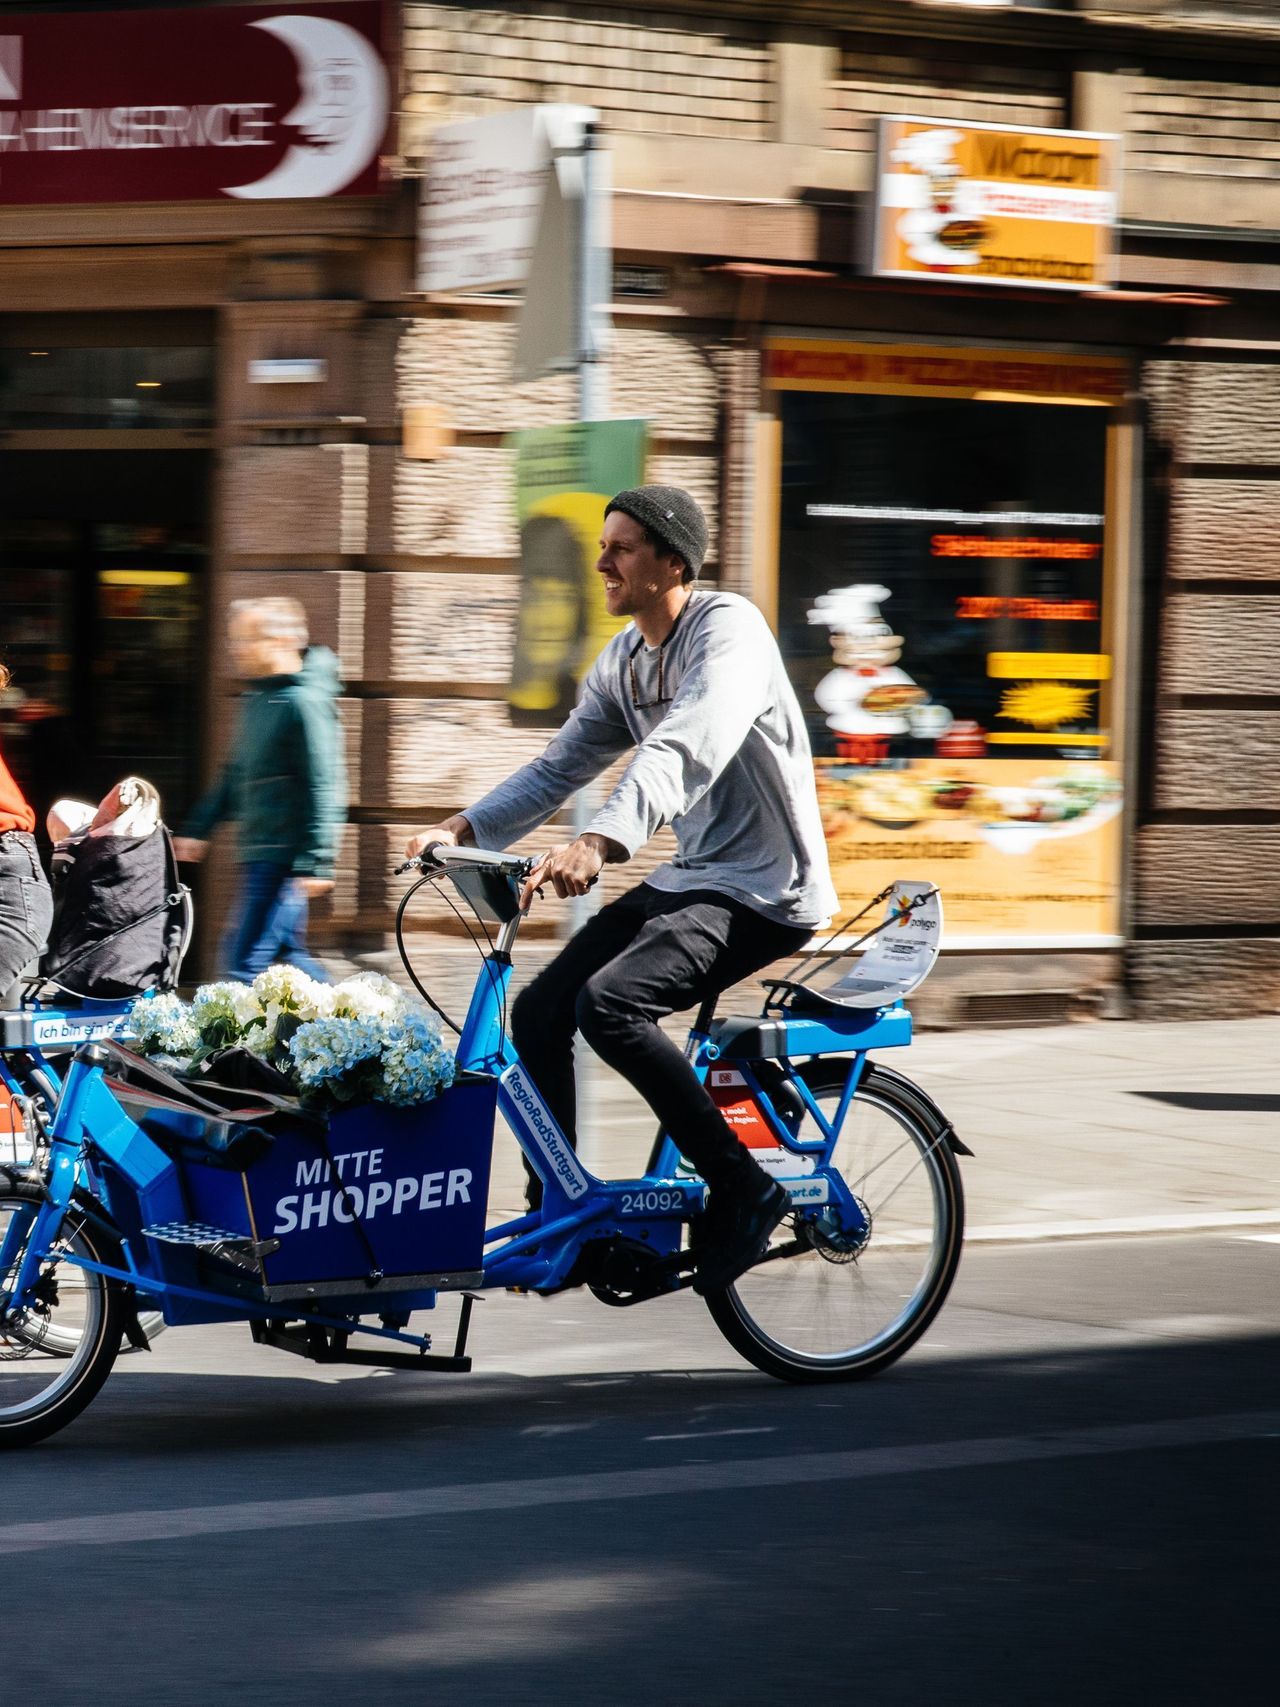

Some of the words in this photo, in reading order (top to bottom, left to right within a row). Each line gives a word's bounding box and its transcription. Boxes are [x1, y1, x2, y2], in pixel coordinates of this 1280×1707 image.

[39, 1024, 58, 1038] Ich
[61, 1023, 80, 1037] bin
[84, 1021, 103, 1035] ein
[507, 1071, 583, 1194] RegioRadStuttgart
[295, 1148, 384, 1187] MITTE
[273, 1168, 473, 1235] SHOPPER
[621, 1190, 683, 1213] 24092
[786, 1186, 822, 1198] art.de
